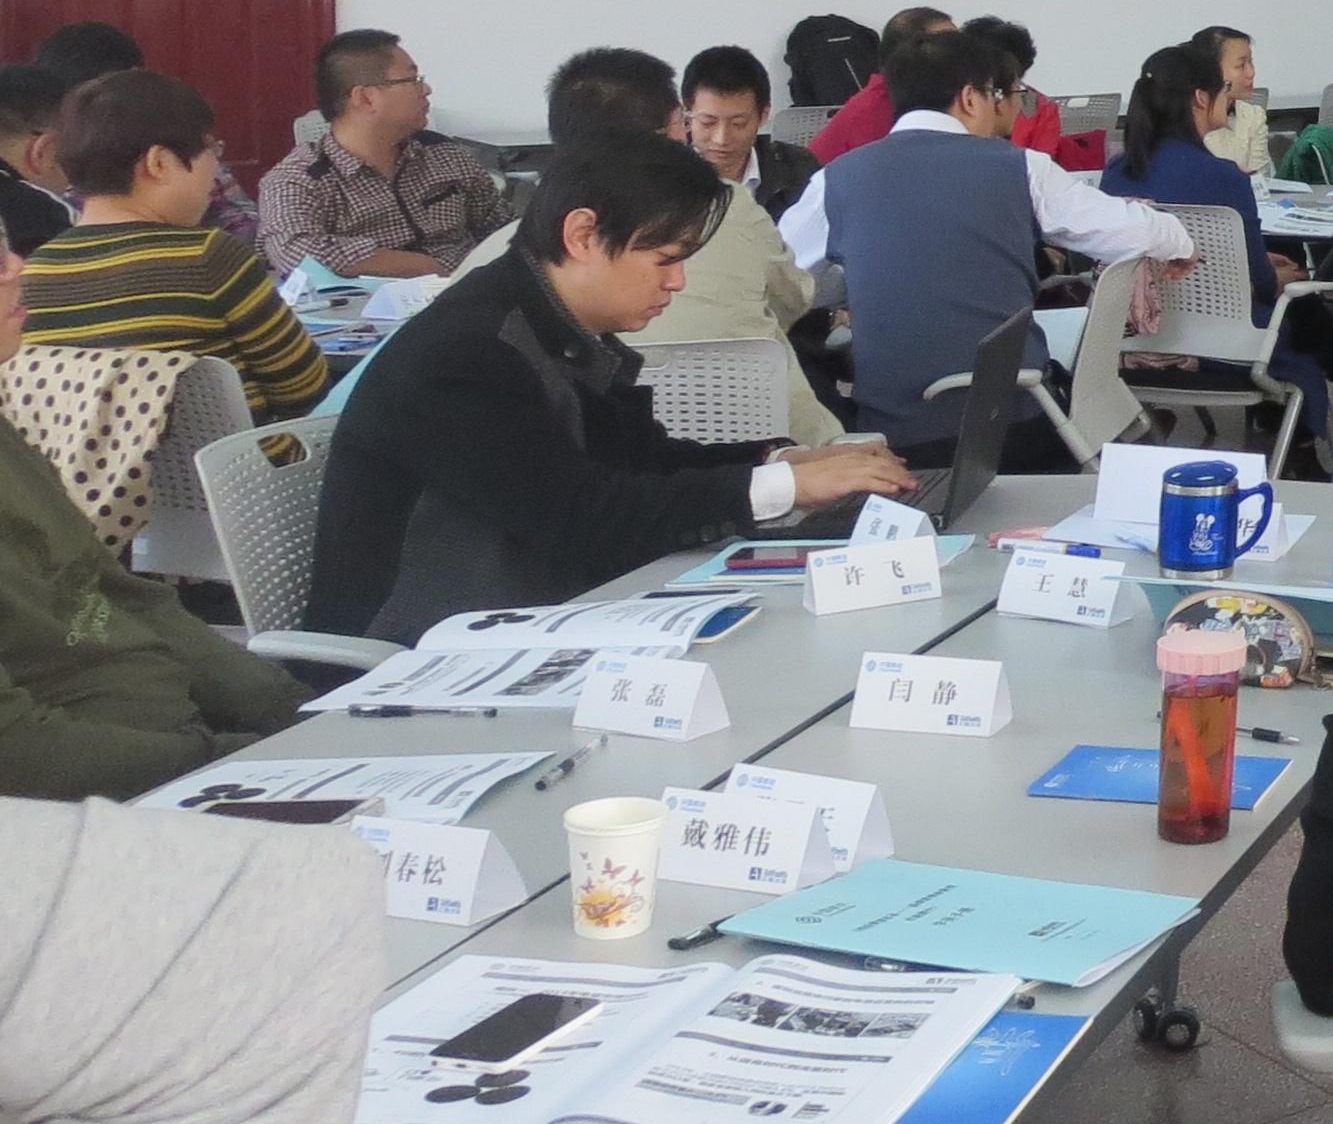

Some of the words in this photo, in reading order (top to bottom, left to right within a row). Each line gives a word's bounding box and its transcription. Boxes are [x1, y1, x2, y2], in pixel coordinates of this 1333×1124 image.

[610, 678, 668, 707] 张磊
[888, 677, 958, 706] 闫静
[679, 817, 773, 857] 戴雅伟
